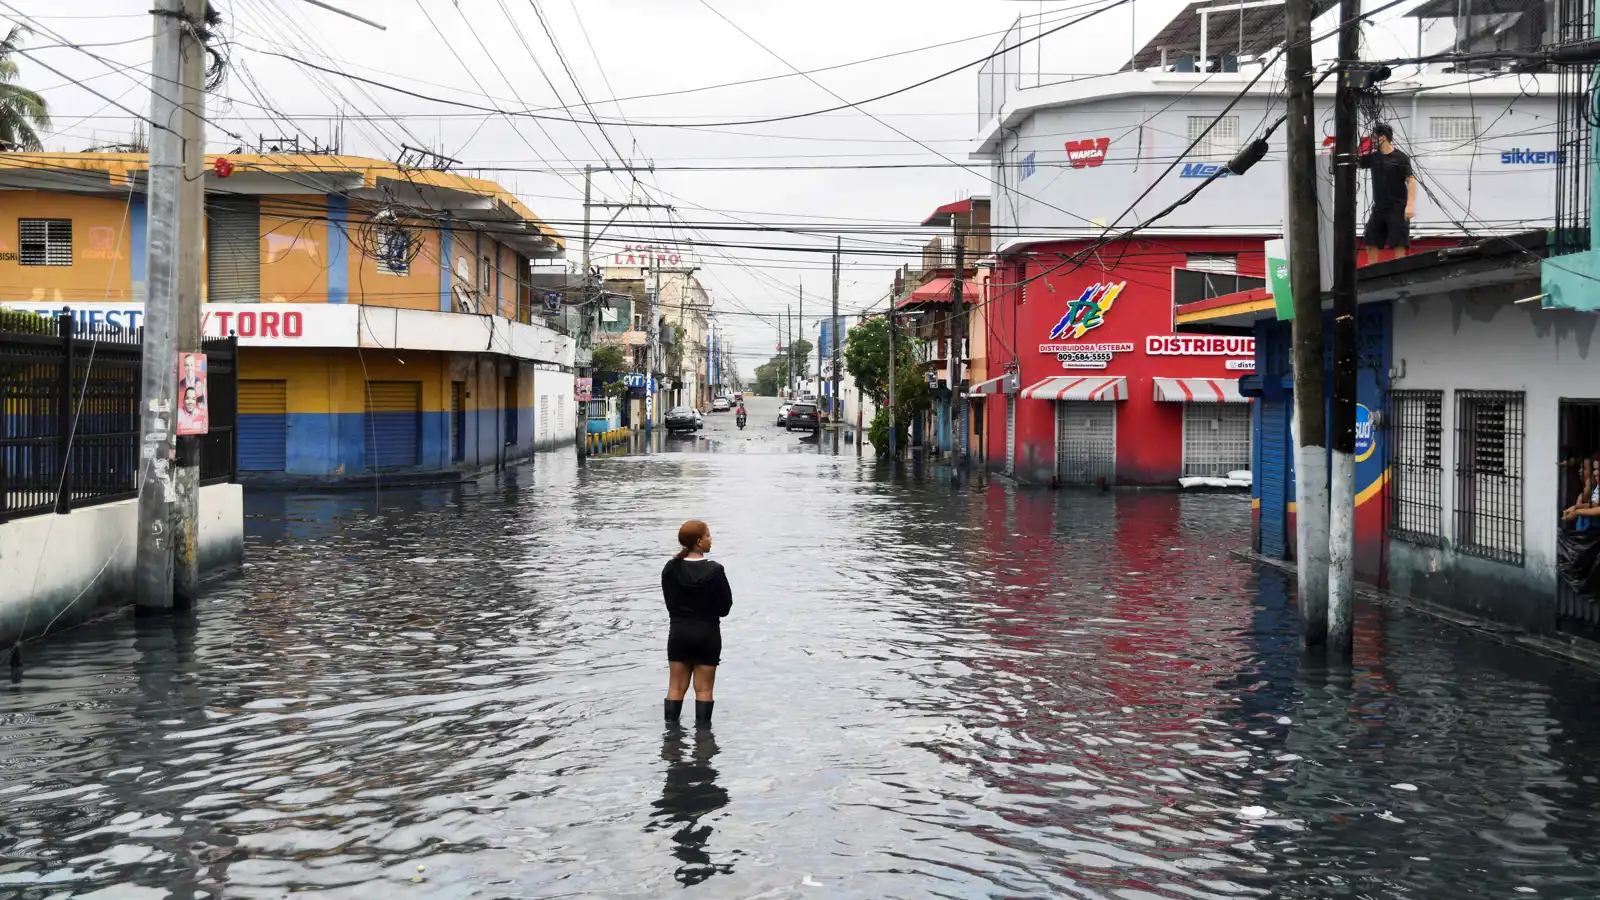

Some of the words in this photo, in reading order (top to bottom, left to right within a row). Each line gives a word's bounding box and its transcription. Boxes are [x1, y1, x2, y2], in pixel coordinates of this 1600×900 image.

[1070, 150, 1103, 160] WANDA
[615, 254, 679, 265] LATNO
[215, 311, 303, 337] TORO
[1040, 344, 1095, 352] DISTRIBUIDORA
[1058, 353, 1111, 361] 809-684-5555
[623, 375, 642, 386] CVT
